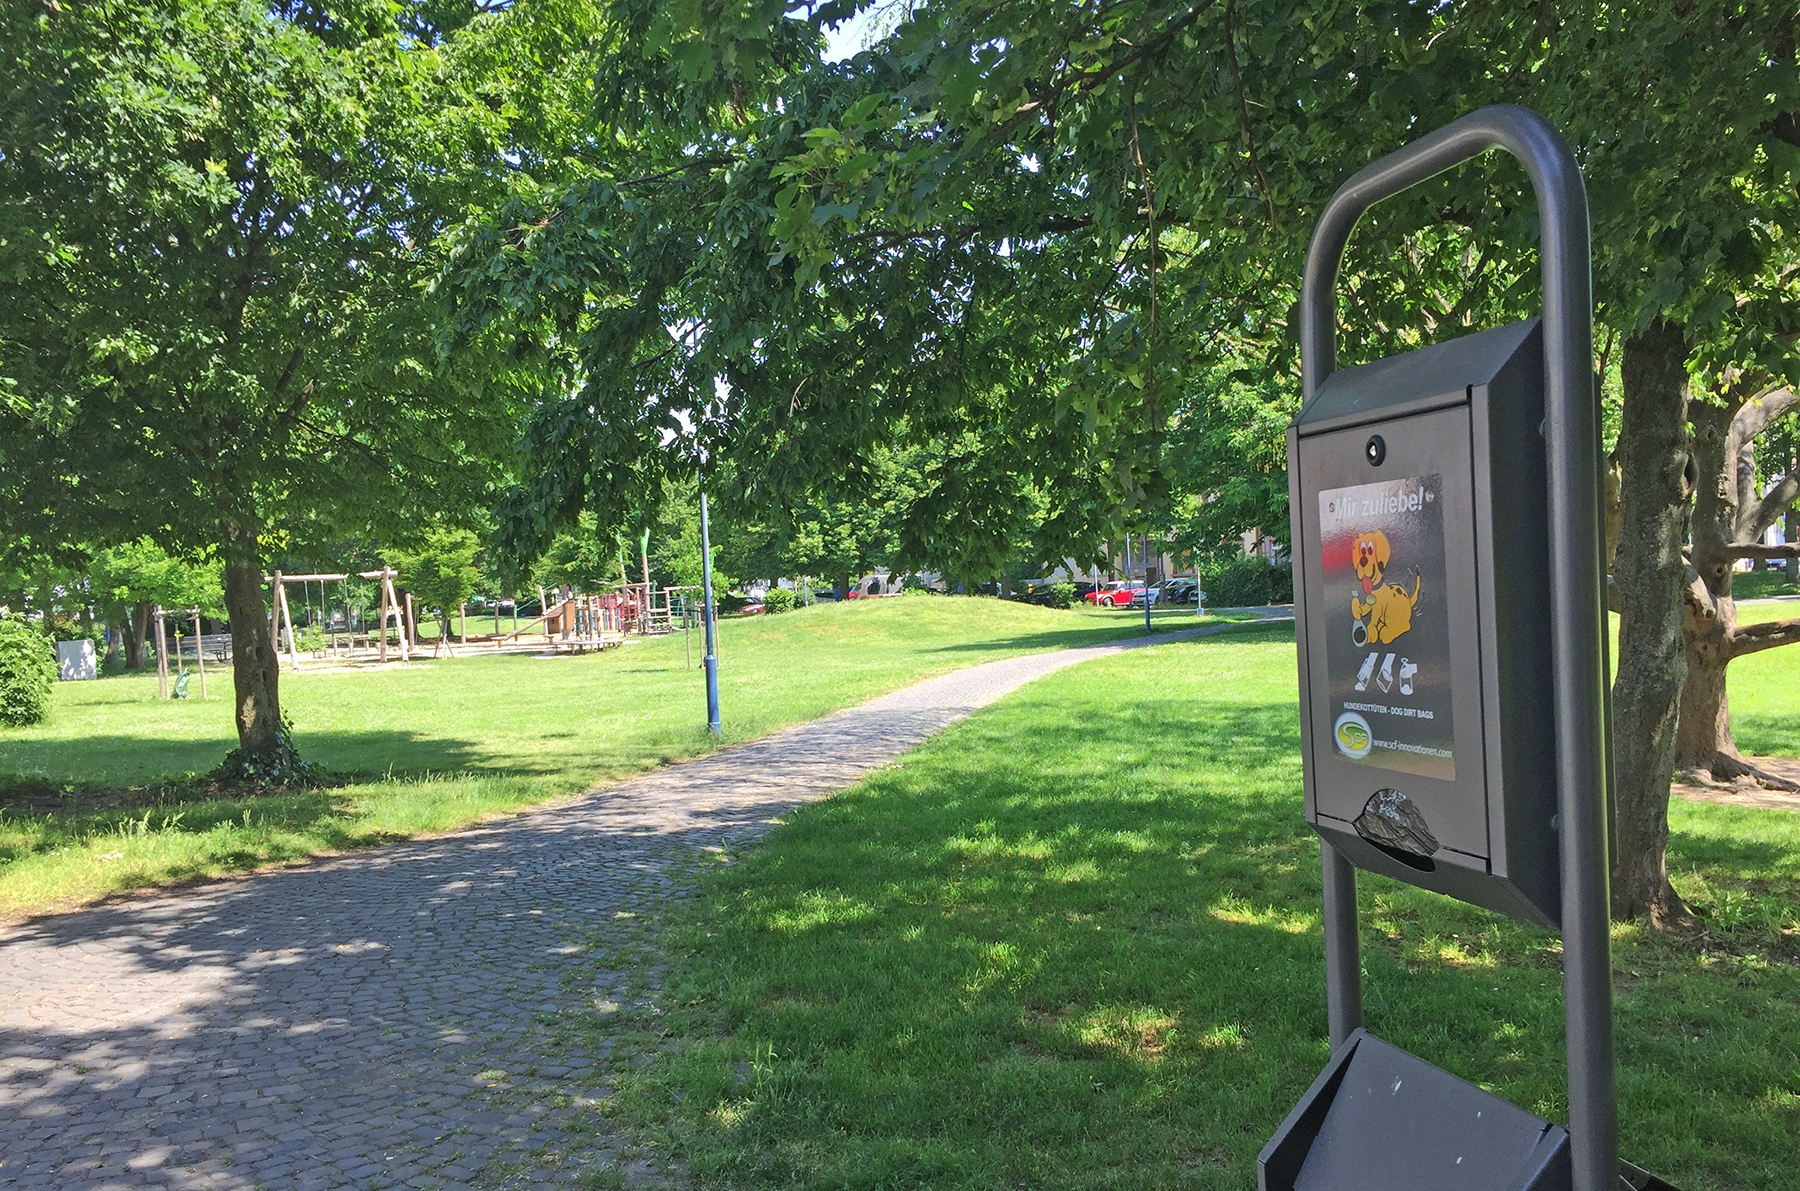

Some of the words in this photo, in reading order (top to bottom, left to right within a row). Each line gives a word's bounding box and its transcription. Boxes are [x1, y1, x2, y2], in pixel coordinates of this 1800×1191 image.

[1335, 497, 1357, 518] Mir
[1362, 486, 1424, 517] zuliebe!
[1343, 702, 1387, 714] HUNDEKOTTÜTEN
[1390, 706, 1403, 717] DOG
[1404, 708, 1417, 718] DIRT
[1417, 709, 1434, 719] BAGS
[1373, 739, 1453, 759] www.scf-innovationen.com
